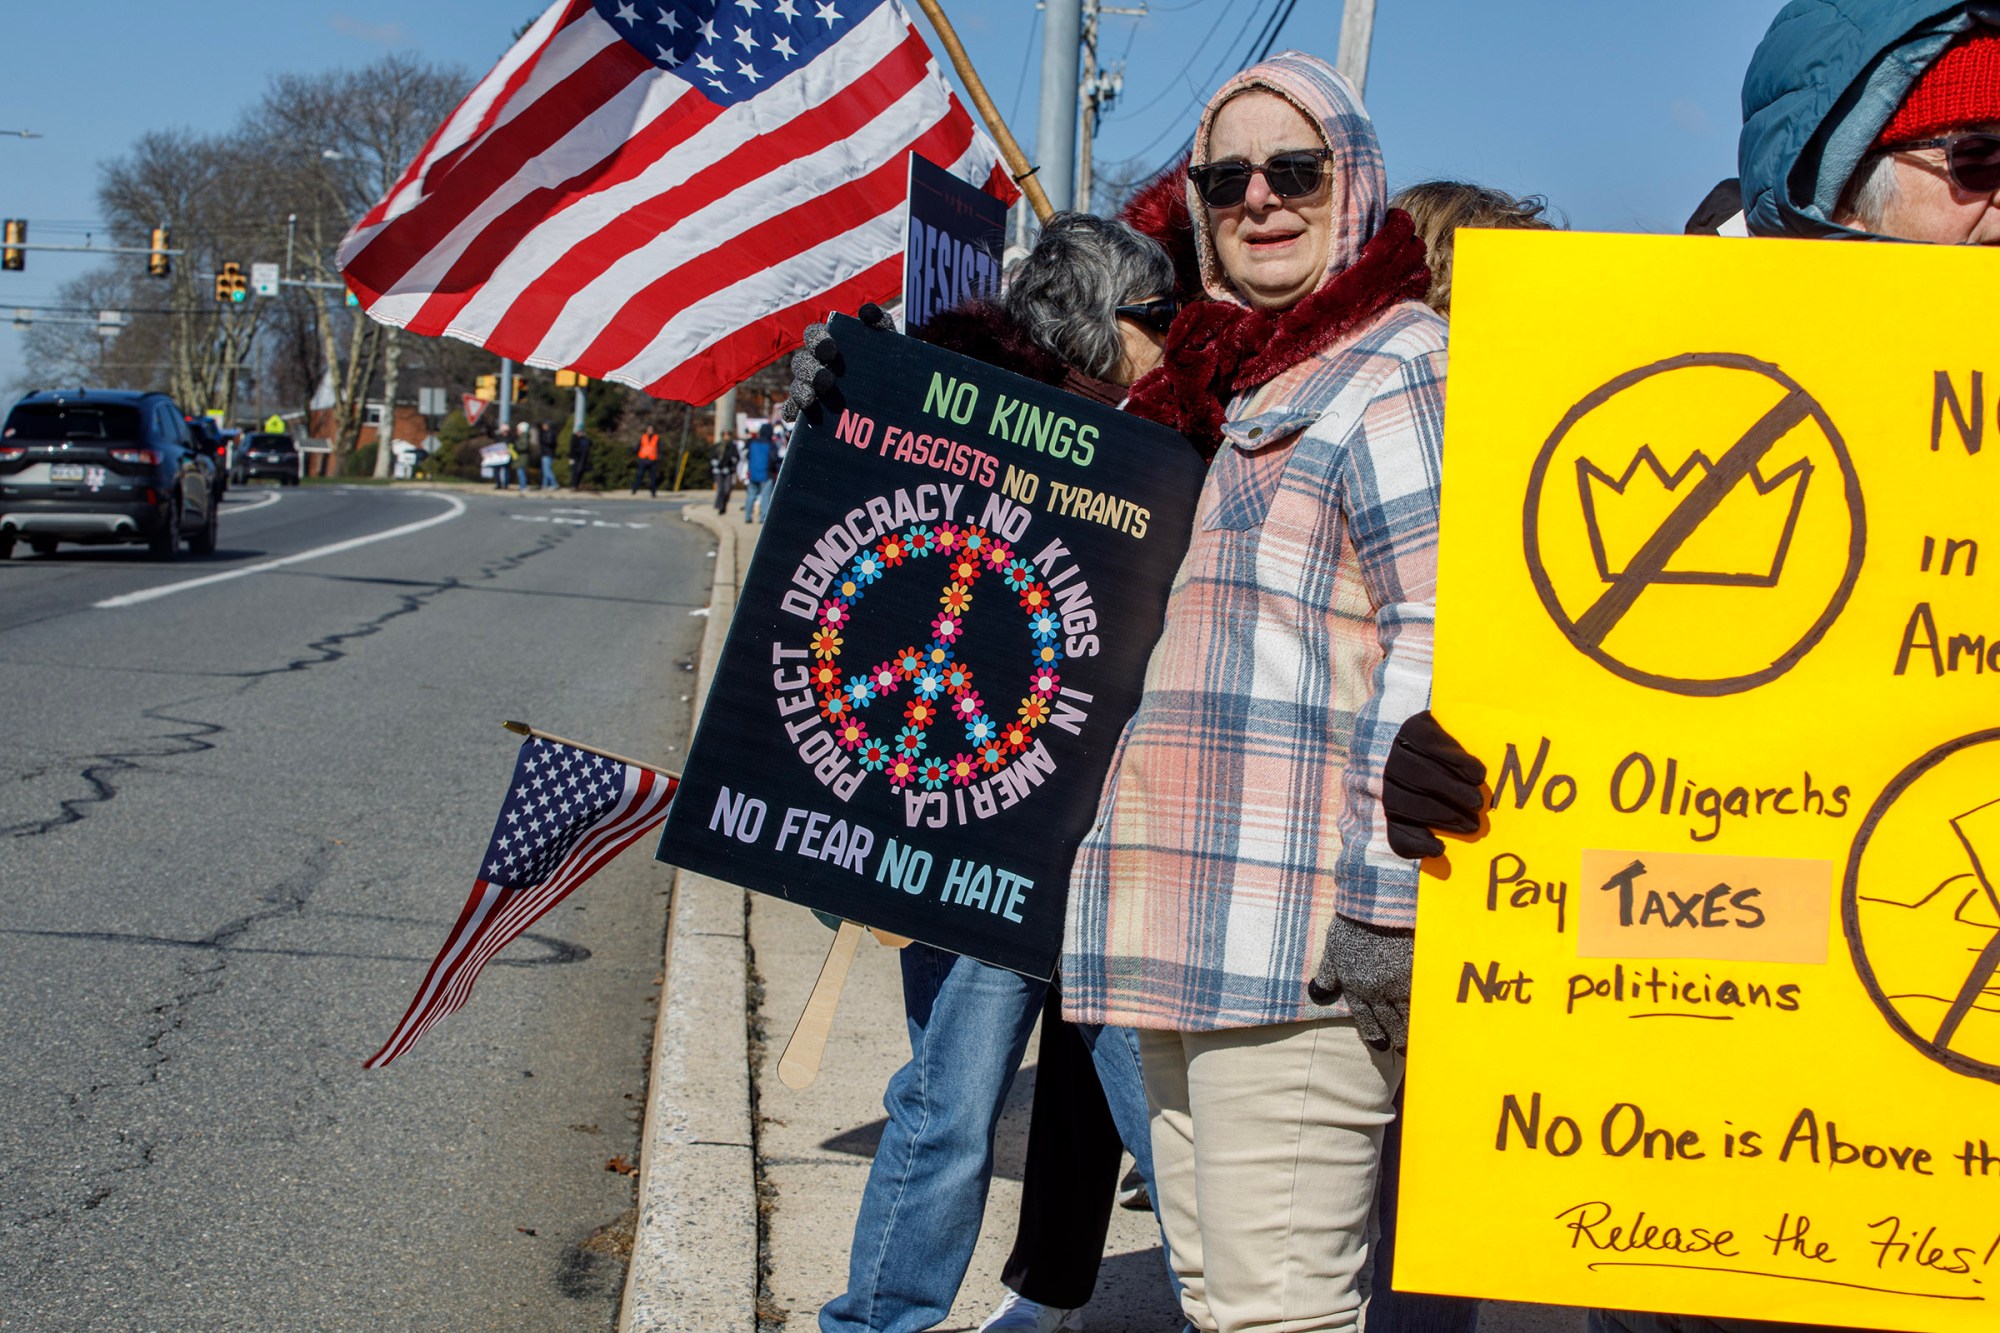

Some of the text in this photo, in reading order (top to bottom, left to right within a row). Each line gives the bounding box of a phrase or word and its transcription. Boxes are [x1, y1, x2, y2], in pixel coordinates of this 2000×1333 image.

[922, 371, 1101, 468] NO KINGS
[1931, 370, 2000, 456] N
[834, 408, 1152, 540] NO FASCISTS NO TYRANTS
[980, 493, 1032, 544] NO
[1920, 535, 1978, 576] in
[1032, 537, 1100, 659] KINGS
[772, 641, 868, 803] PROTECT
[1048, 686, 1094, 736] IN
[1492, 736, 1851, 842] No Oligarchs
[708, 785, 1035, 924] NO FEAR NO HATE
[1486, 852, 1766, 933] Pay TAXES
[1456, 961, 1801, 1015] Not politicians
[1494, 1092, 1582, 1158] No
[1600, 1102, 1706, 1162] One
[1723, 1120, 1763, 1159] is
[1779, 1108, 1934, 1176] Above
[1555, 1201, 1740, 1257] Release
[1764, 1213, 1838, 1264] the
